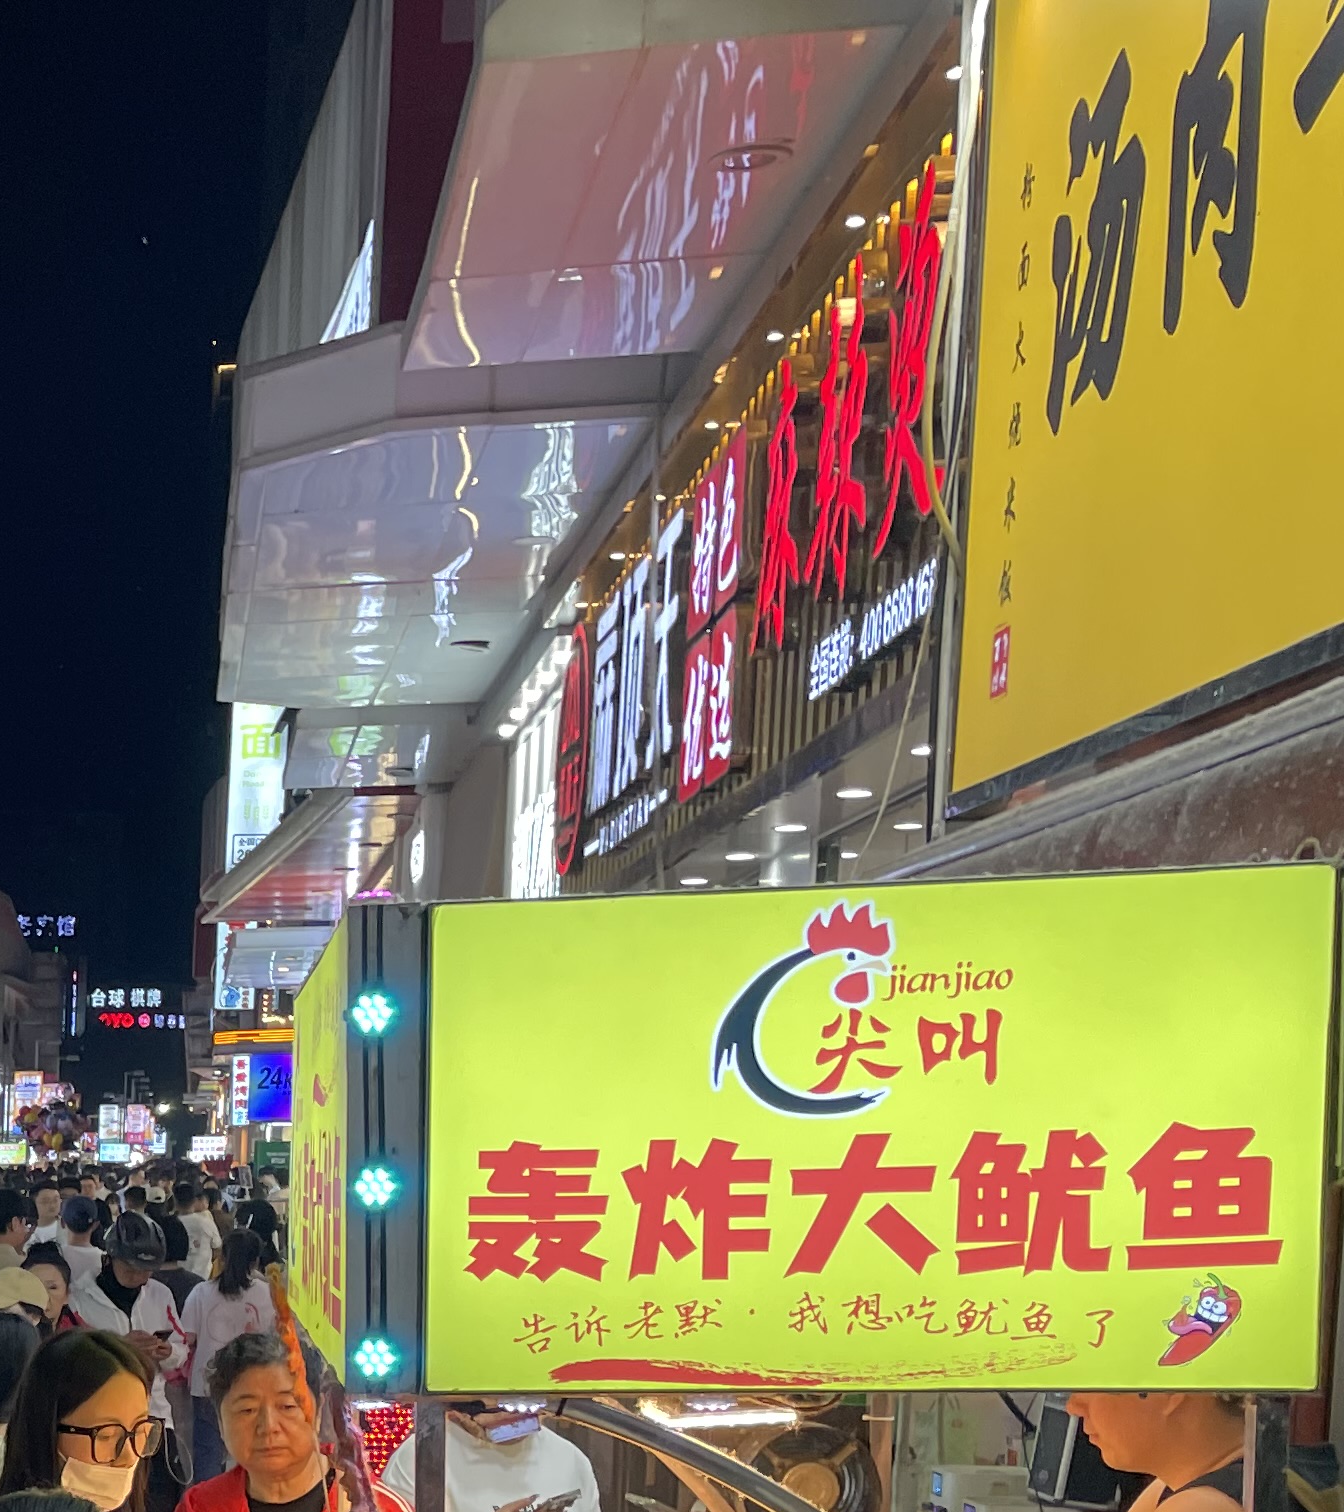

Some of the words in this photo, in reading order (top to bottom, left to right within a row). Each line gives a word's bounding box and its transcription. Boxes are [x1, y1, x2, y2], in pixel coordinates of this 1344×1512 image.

[692, 455, 740, 615] 特色
[91, 987, 125, 1008] 台球
[130, 987, 162, 1008] 棋牌
[882, 961, 1014, 1001] jianjiao
[807, 1009, 1004, 1096] 尖叫
[464, 1122, 1284, 1282] 轰炸大鱿鱼
